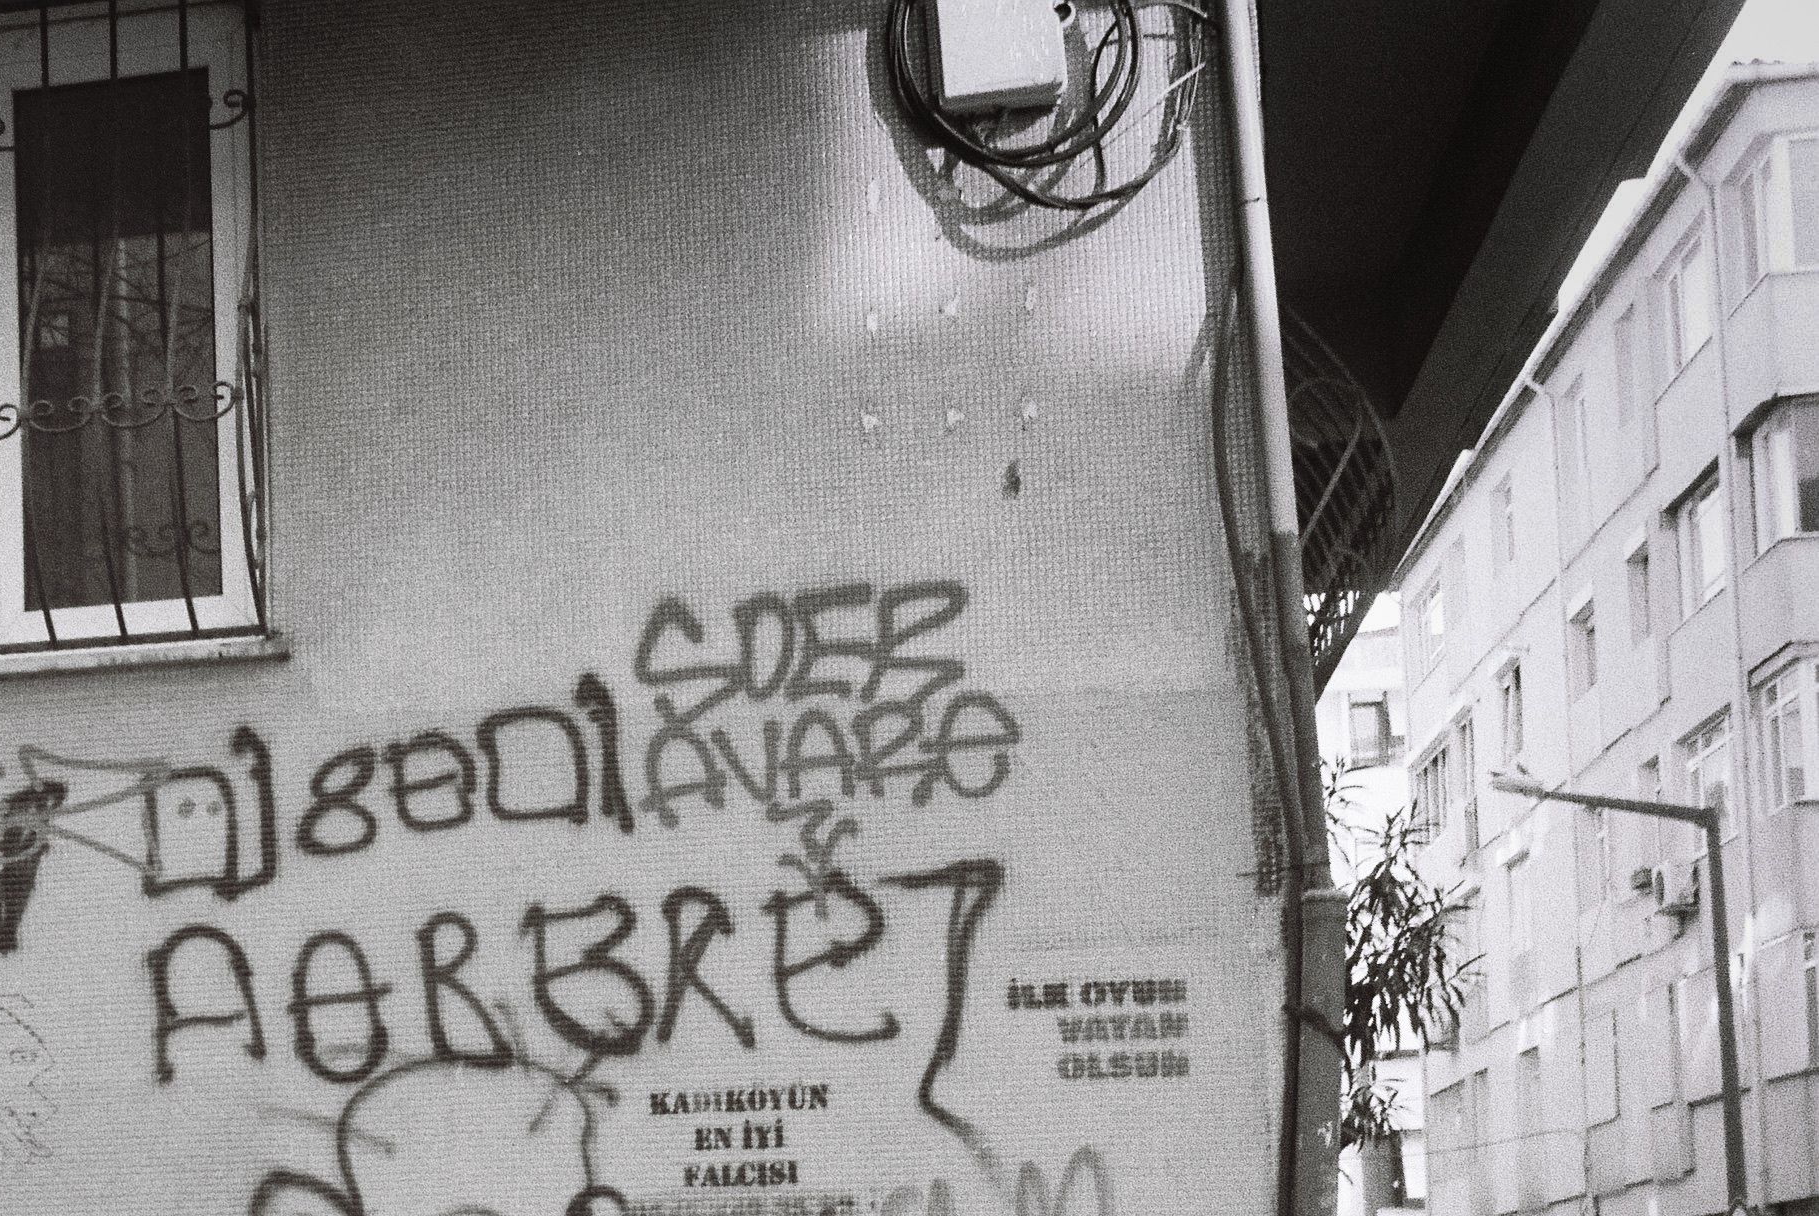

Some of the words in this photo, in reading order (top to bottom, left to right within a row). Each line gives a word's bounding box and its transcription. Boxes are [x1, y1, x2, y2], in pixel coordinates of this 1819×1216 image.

[649, 1080, 830, 1116] KADIKÖYÜN
[694, 1127, 733, 1151] EN
[742, 1119, 785, 1150] İYİ
[684, 1161, 799, 1188] FALCISI
